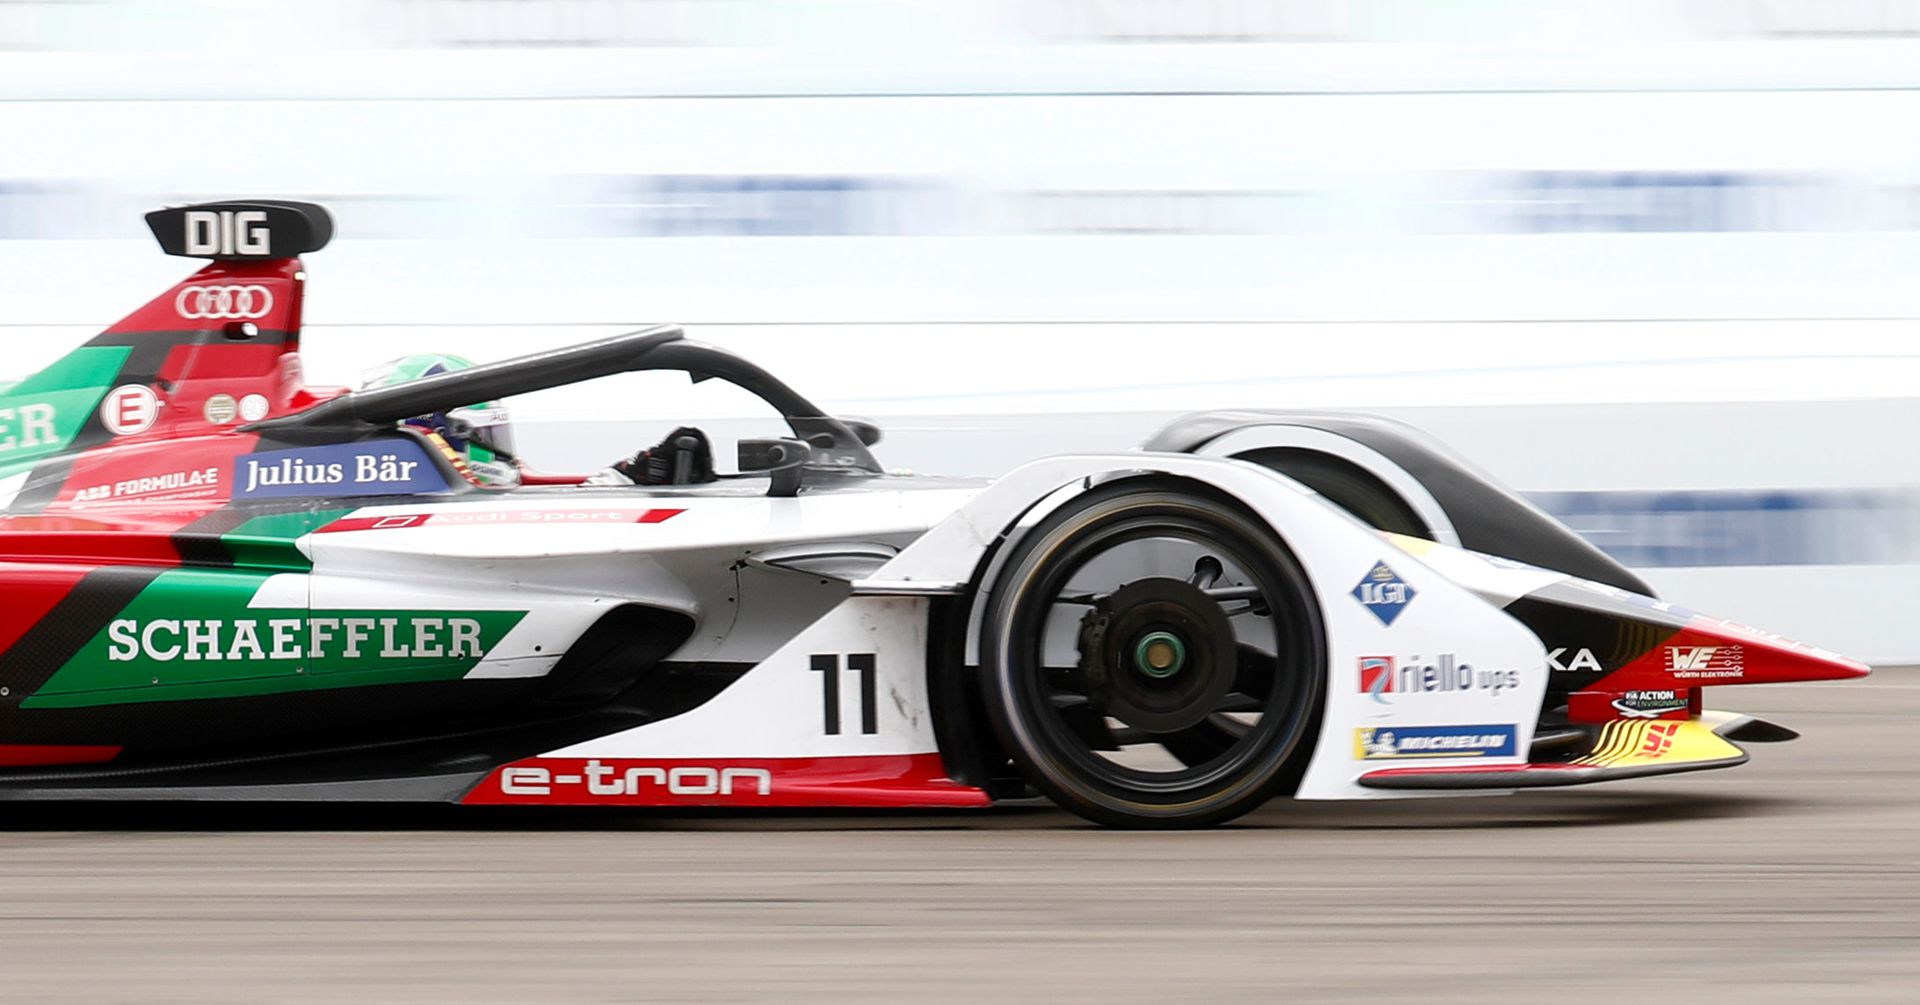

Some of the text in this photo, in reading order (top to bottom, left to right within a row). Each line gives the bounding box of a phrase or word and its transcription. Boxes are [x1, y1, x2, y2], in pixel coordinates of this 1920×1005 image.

[185, 211, 271, 255] DIG
[246, 454, 418, 491] Julius Bär
[428, 508, 624, 523] Audi Sport
[1360, 583, 1408, 604] LGT
[108, 618, 483, 661] SCHAEFFLER
[1672, 647, 1717, 670] WE
[1399, 654, 1520, 696] riello ups
[810, 653, 878, 735] 11
[1637, 699, 1688, 707] ENVIRONMENT
[1639, 691, 1674, 700] ACTION
[1398, 733, 1508, 750] MICHELIN
[500, 761, 770, 796] e-tron
